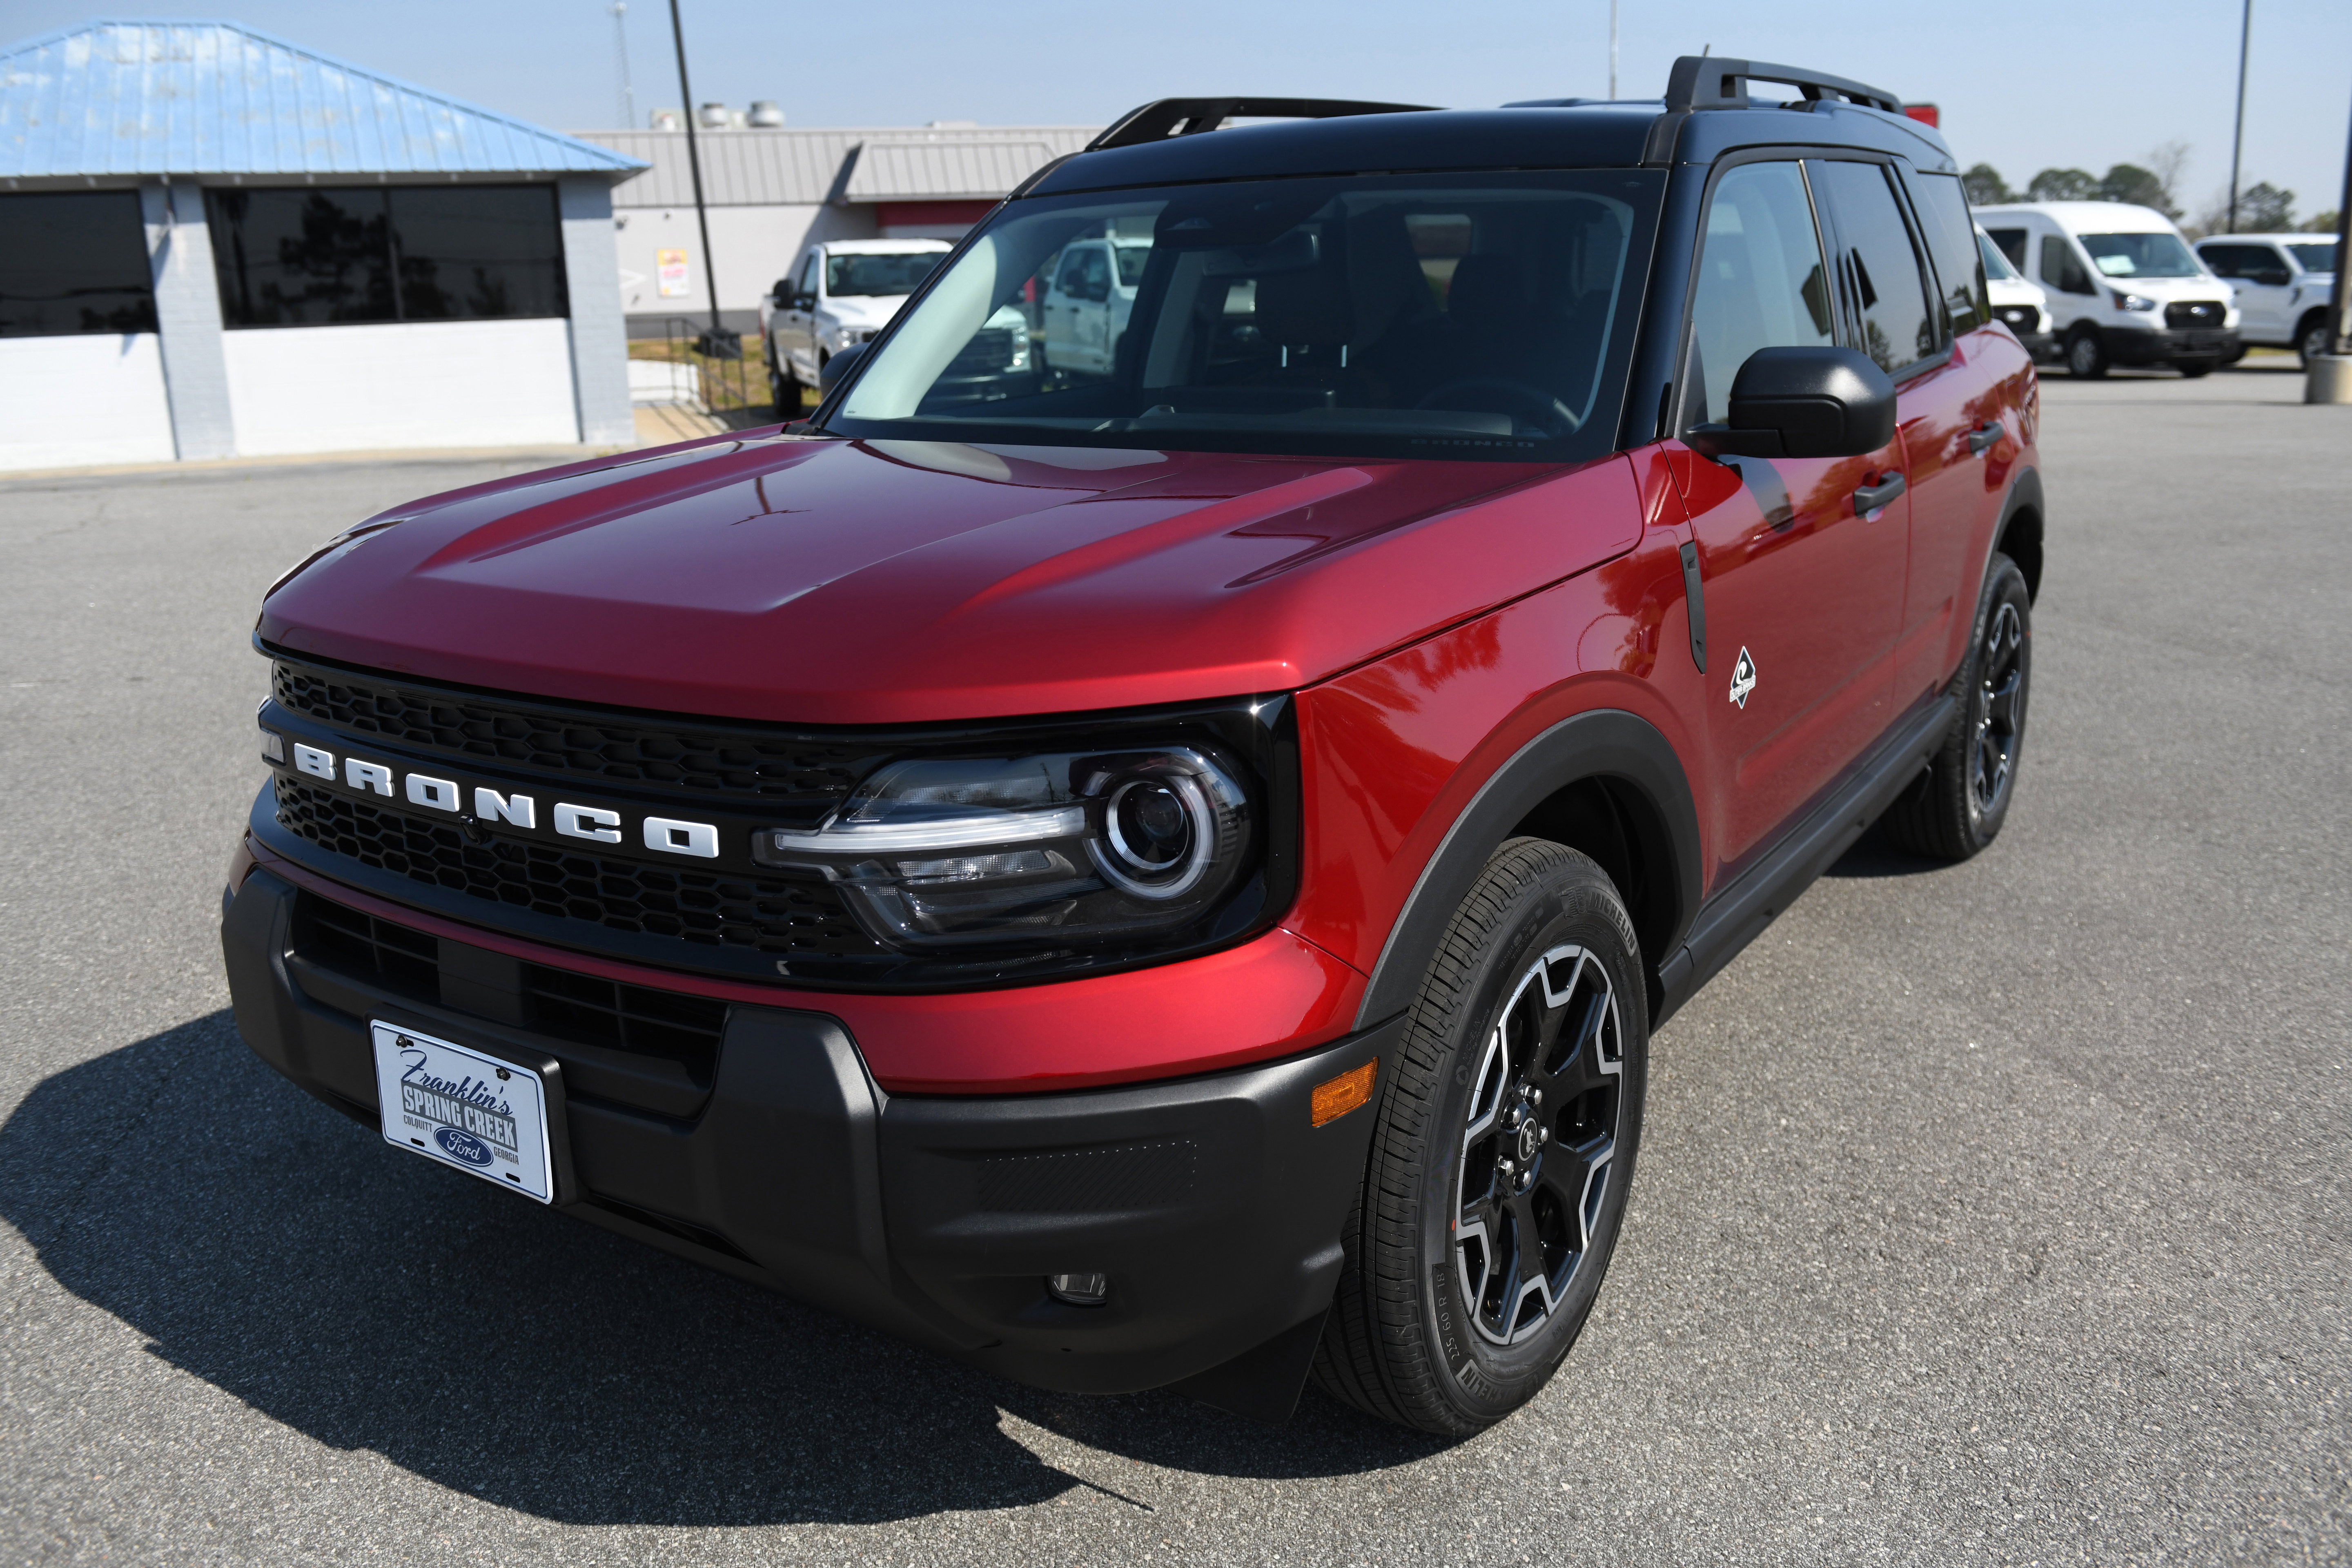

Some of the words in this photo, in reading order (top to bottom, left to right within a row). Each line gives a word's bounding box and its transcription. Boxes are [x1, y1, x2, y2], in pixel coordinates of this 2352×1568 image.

[293, 742, 719, 858] BRONCO
[1588, 892, 1635, 950] MICHELIN
[1463, 1017, 1480, 1062] MICHELIN
[400, 1049, 513, 1116] Franklin's
[403, 1085, 461, 1127] SPRING
[464, 1105, 516, 1149] CREEK
[403, 1115, 433, 1133] COLQUITT
[493, 1146, 519, 1166] GEORGIA
[447, 1132, 481, 1161] Ford
[1439, 1296, 1447, 1307] R
